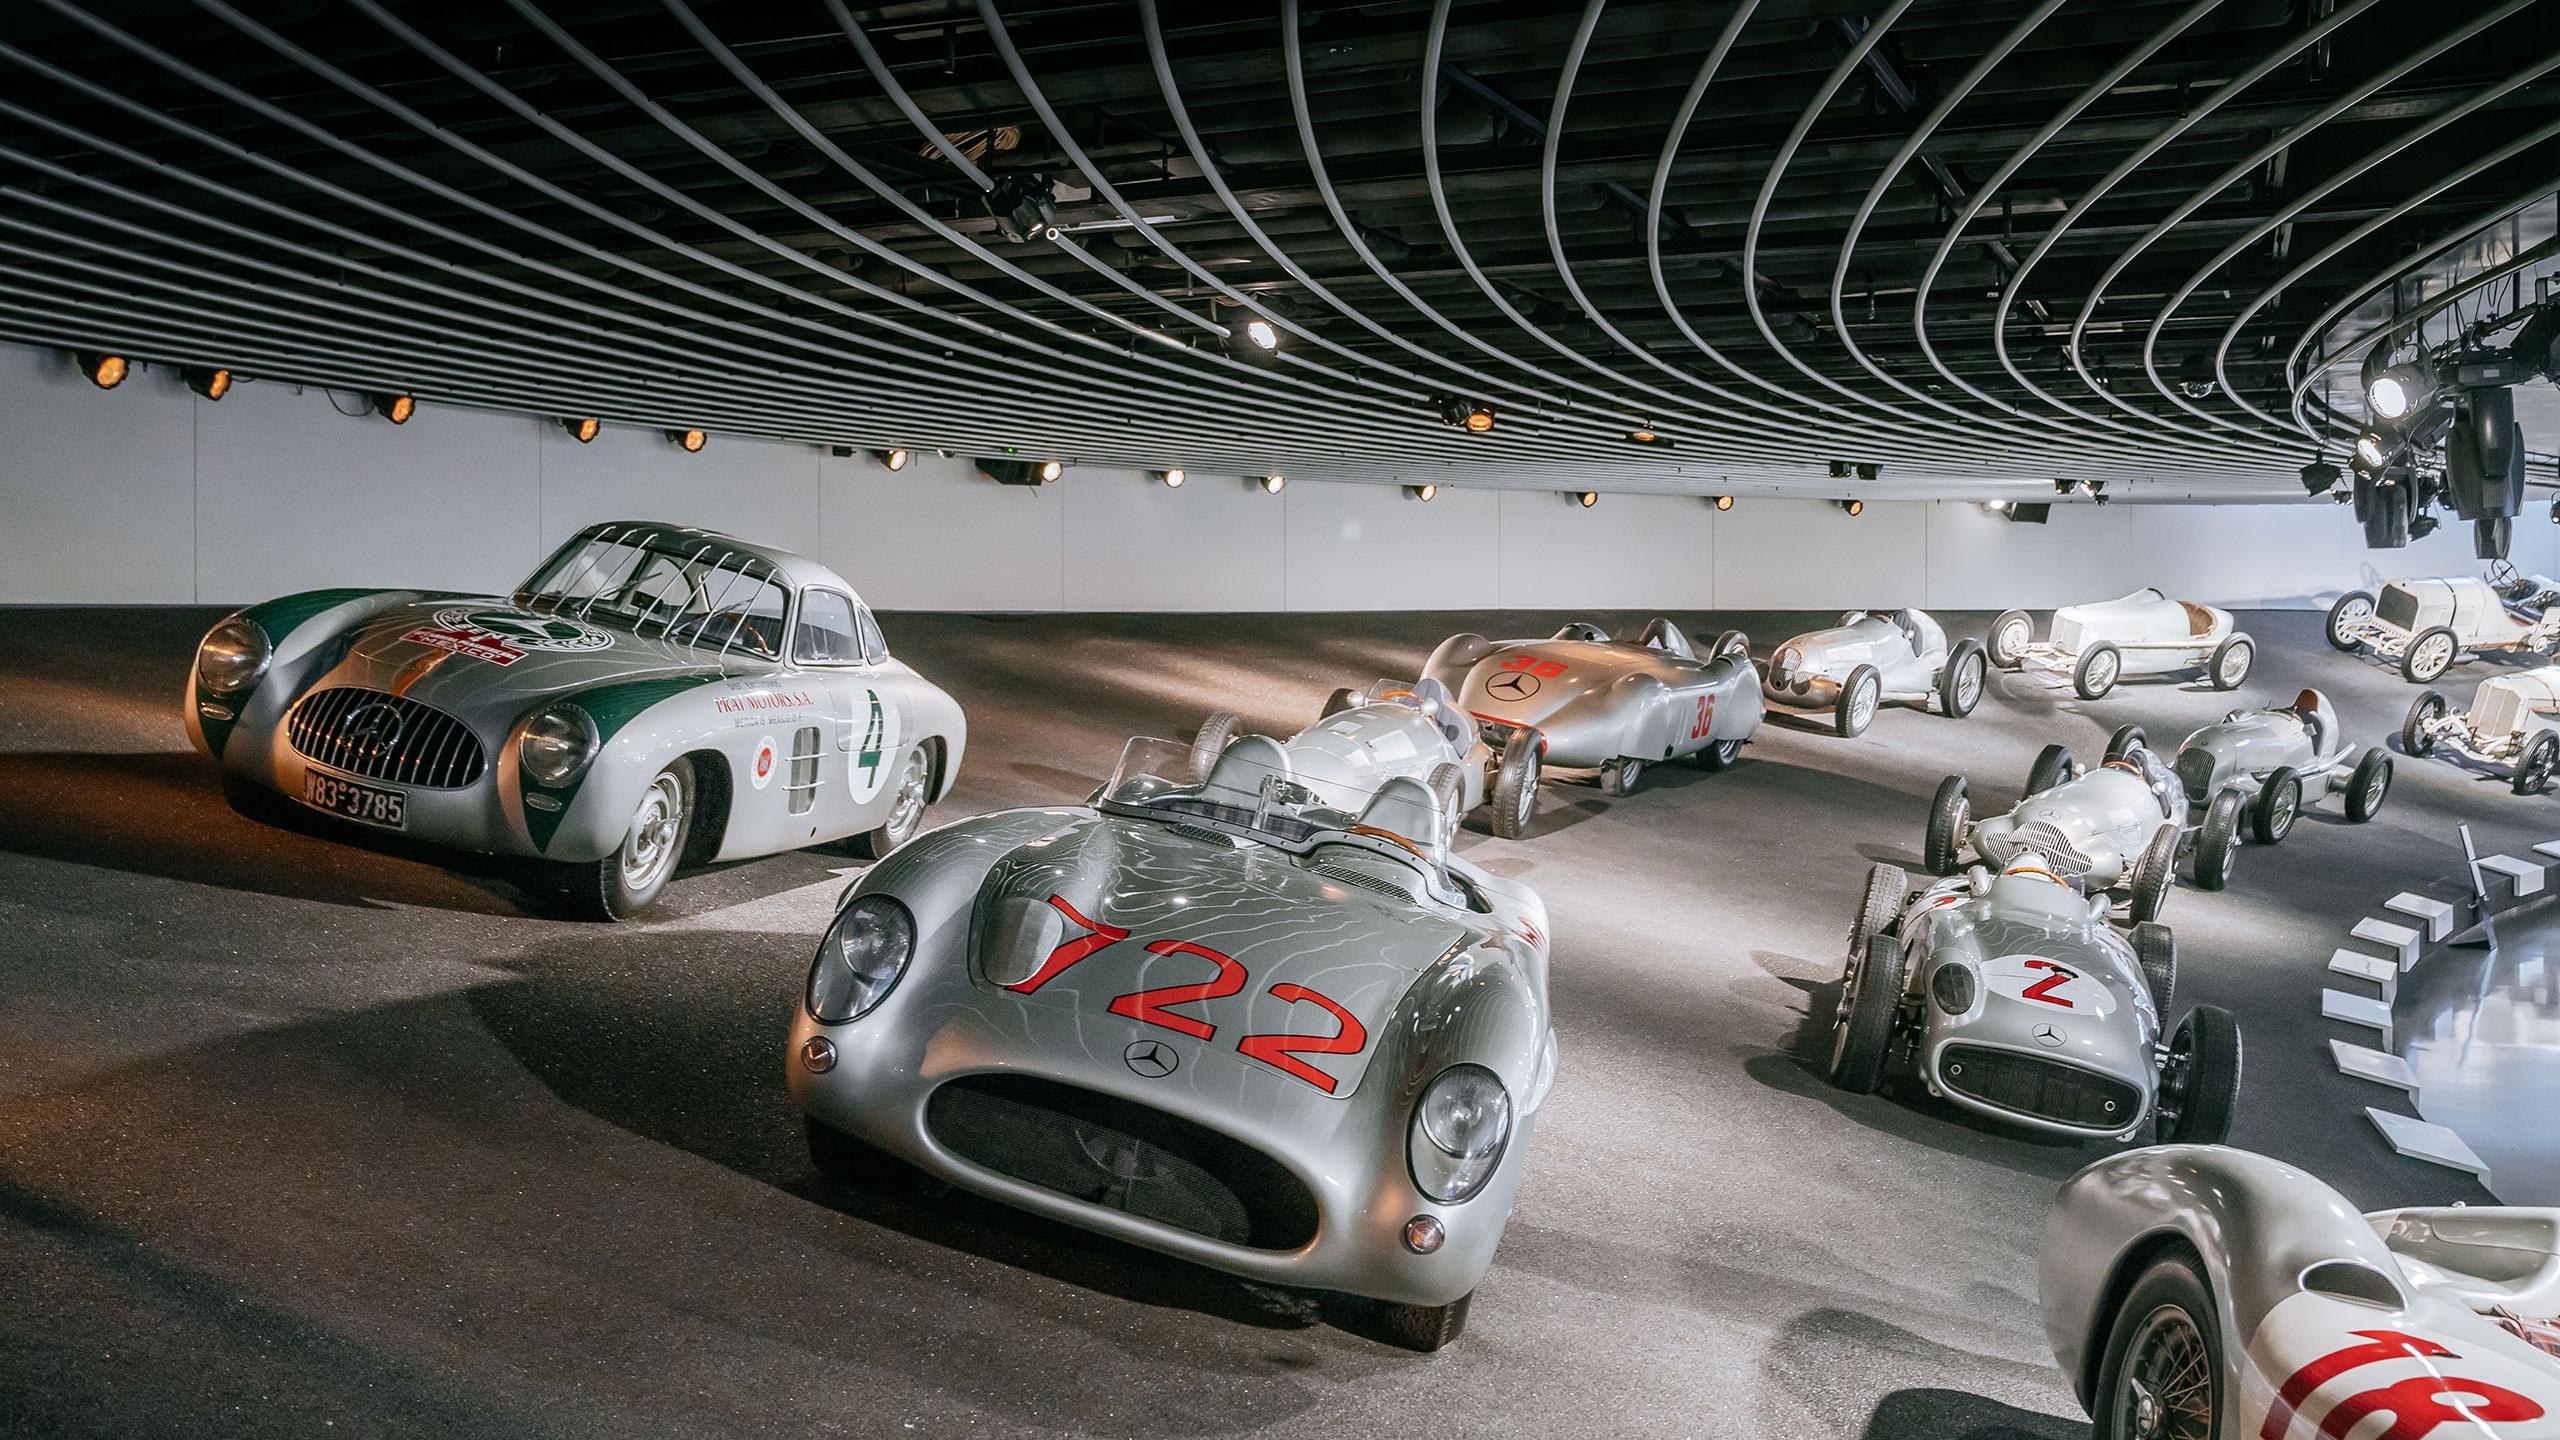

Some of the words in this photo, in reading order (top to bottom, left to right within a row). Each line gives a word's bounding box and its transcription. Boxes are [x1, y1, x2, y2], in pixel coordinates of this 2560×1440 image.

[859, 688, 883, 789] 4
[1690, 694, 1716, 739] 36
[1004, 894, 1368, 1095] 722
[2022, 961, 2078, 1008] 2
